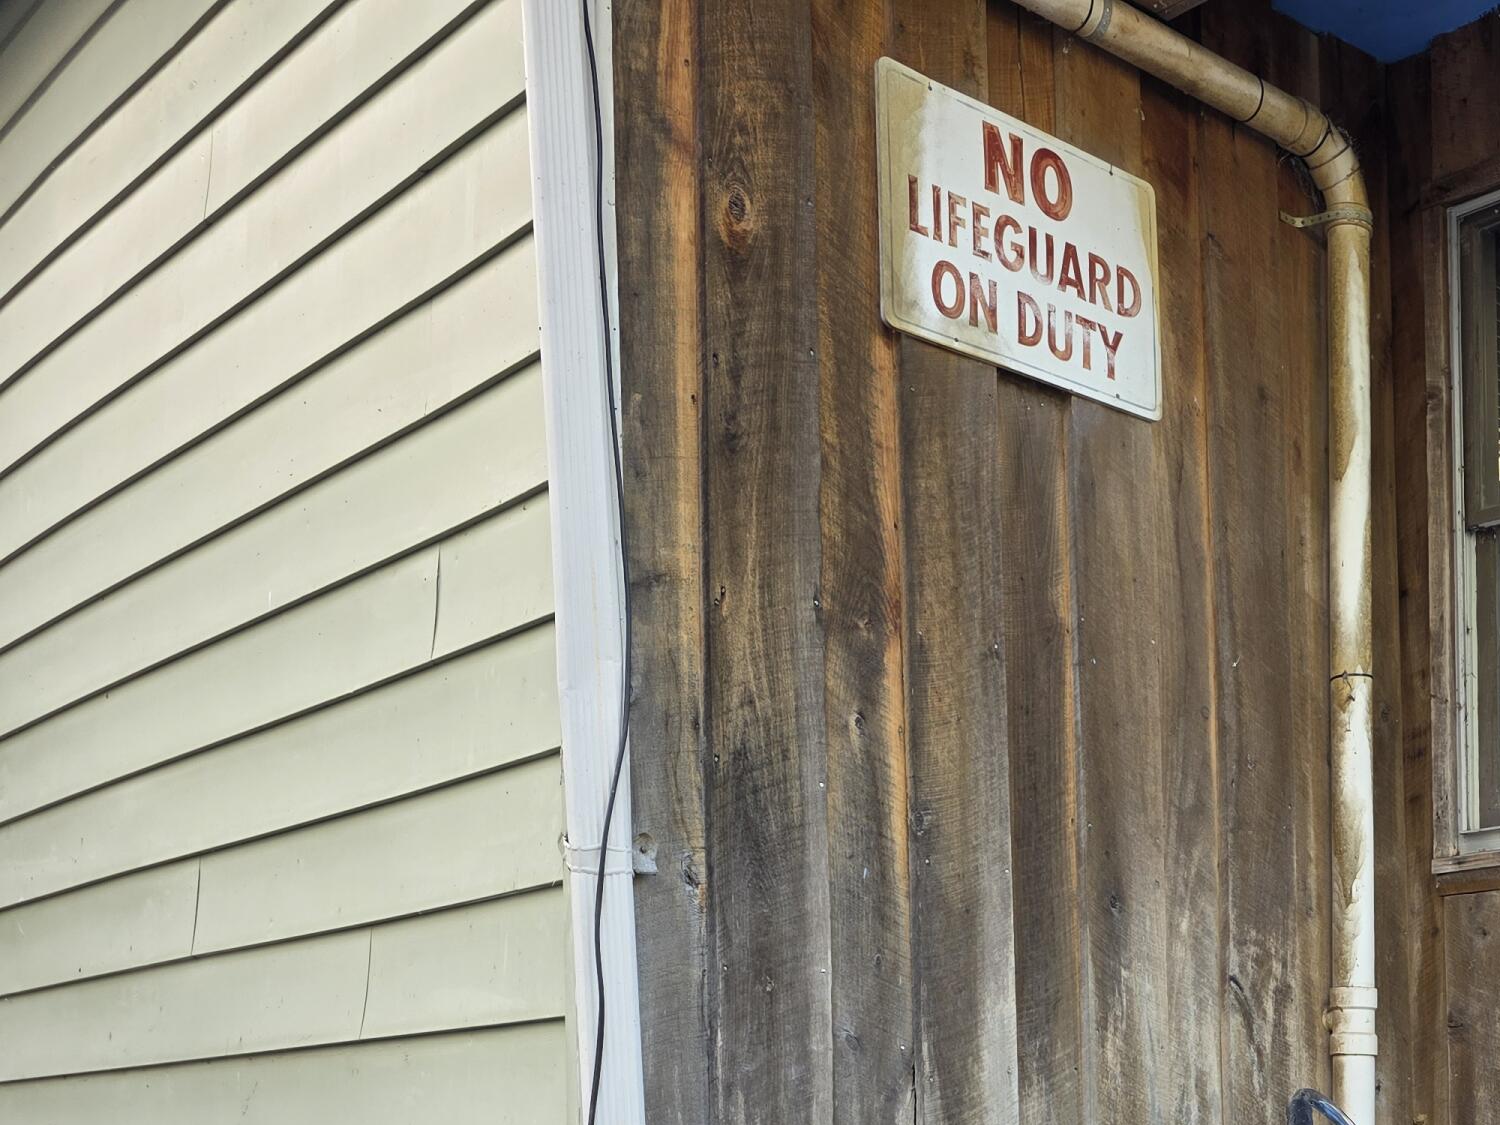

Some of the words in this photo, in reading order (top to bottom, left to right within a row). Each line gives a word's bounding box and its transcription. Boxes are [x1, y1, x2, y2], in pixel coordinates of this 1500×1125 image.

[982, 120, 1073, 221] NO
[907, 174, 1142, 318] LIFEGUARD
[931, 259, 999, 335] ON
[1017, 290, 1124, 381] DUTY
